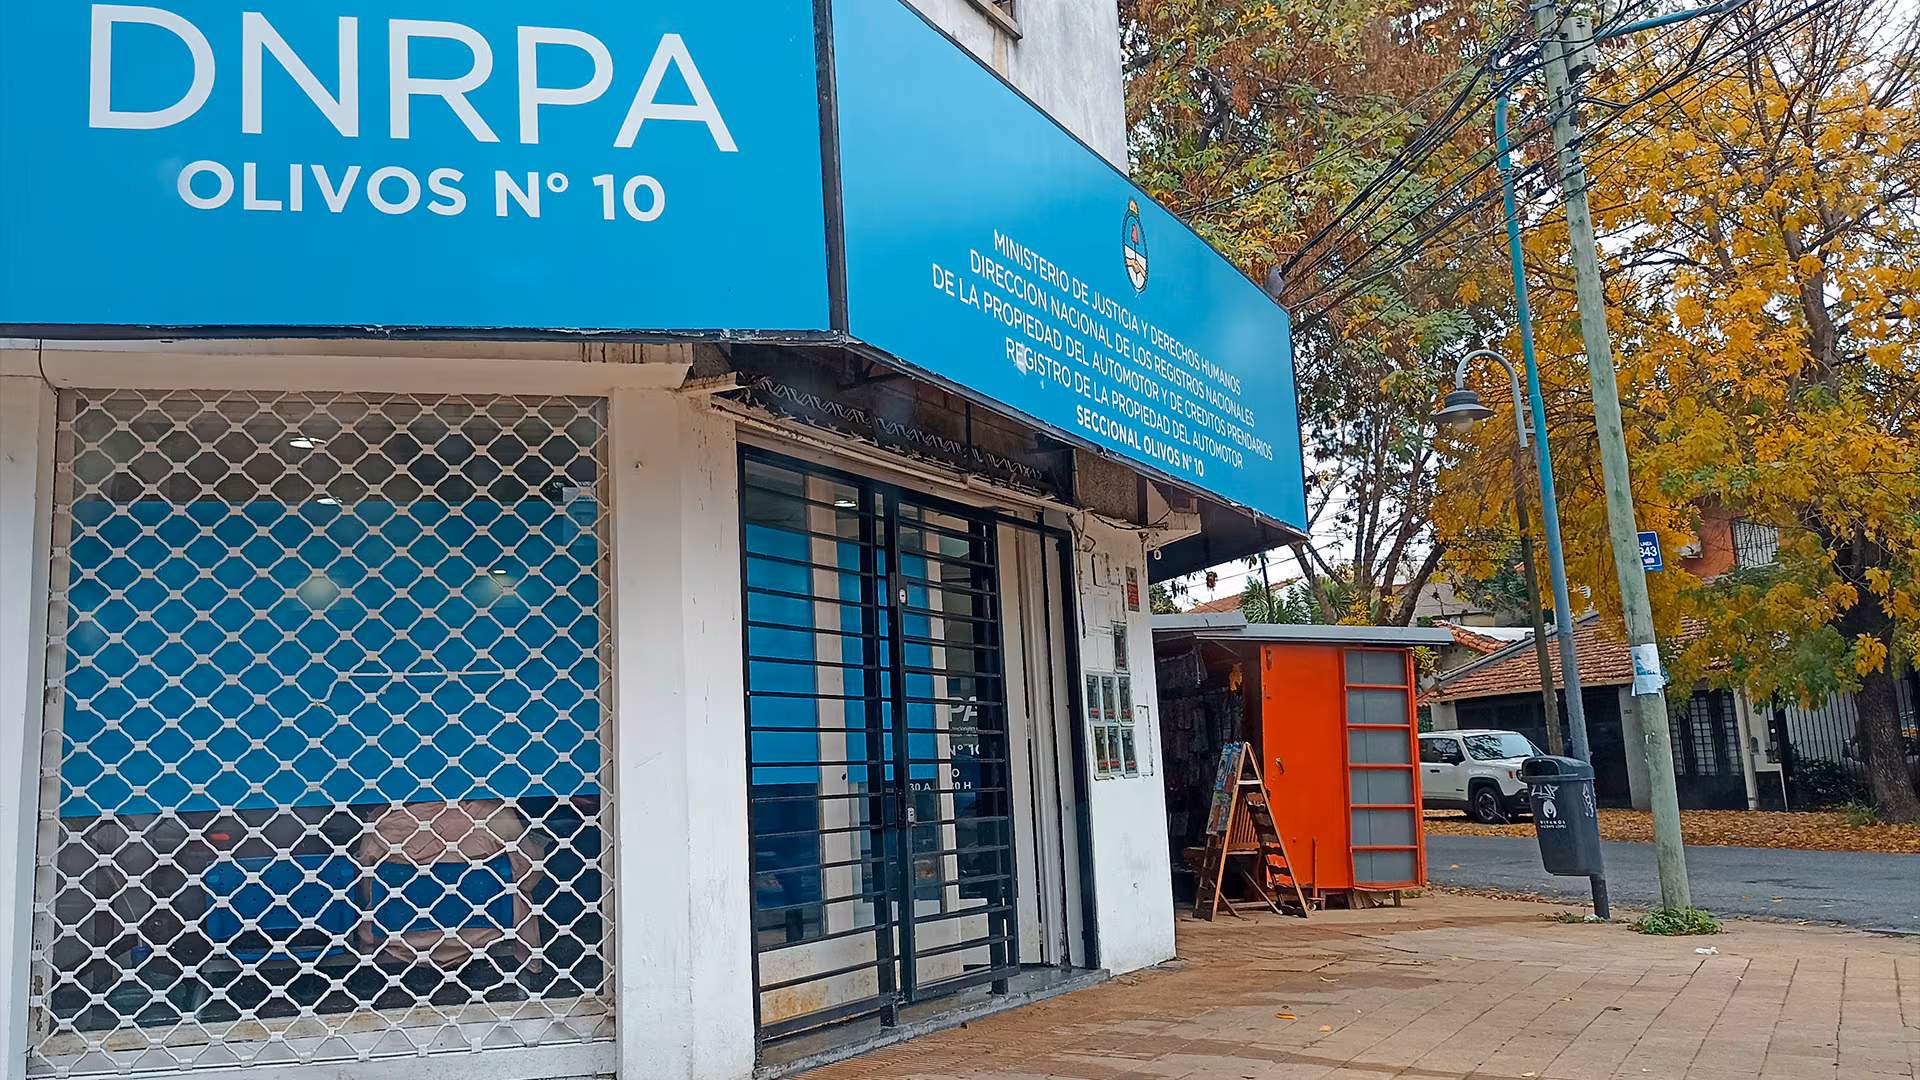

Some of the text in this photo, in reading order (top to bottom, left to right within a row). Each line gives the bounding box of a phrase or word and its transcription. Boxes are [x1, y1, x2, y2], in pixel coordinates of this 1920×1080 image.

[88, 3, 740, 153] DNRPA
[176, 159, 468, 217] OLIVOS
[592, 173, 666, 223] 10
[932, 262, 1273, 462] DE LA PROPIEDAD DEL AUTOMOTOR Y DE CREDITOS PRENDARIOS
[969, 248, 1255, 428] DIRECCION NACIONAL DE LOS REGISTROS NACIONALES
[993, 228, 1241, 396] MINISTERIO DE JUSTICIA Y DERECHOS HUMANOS
[1005, 336, 1244, 470] REGISTRO DE LA PROPIEDAD DEL AUTOMOTOR
[1075, 404, 1142, 451] SECCIONAL
[1143, 434, 1181, 468] OLIVOS
[1193, 457, 1205, 478] 10
